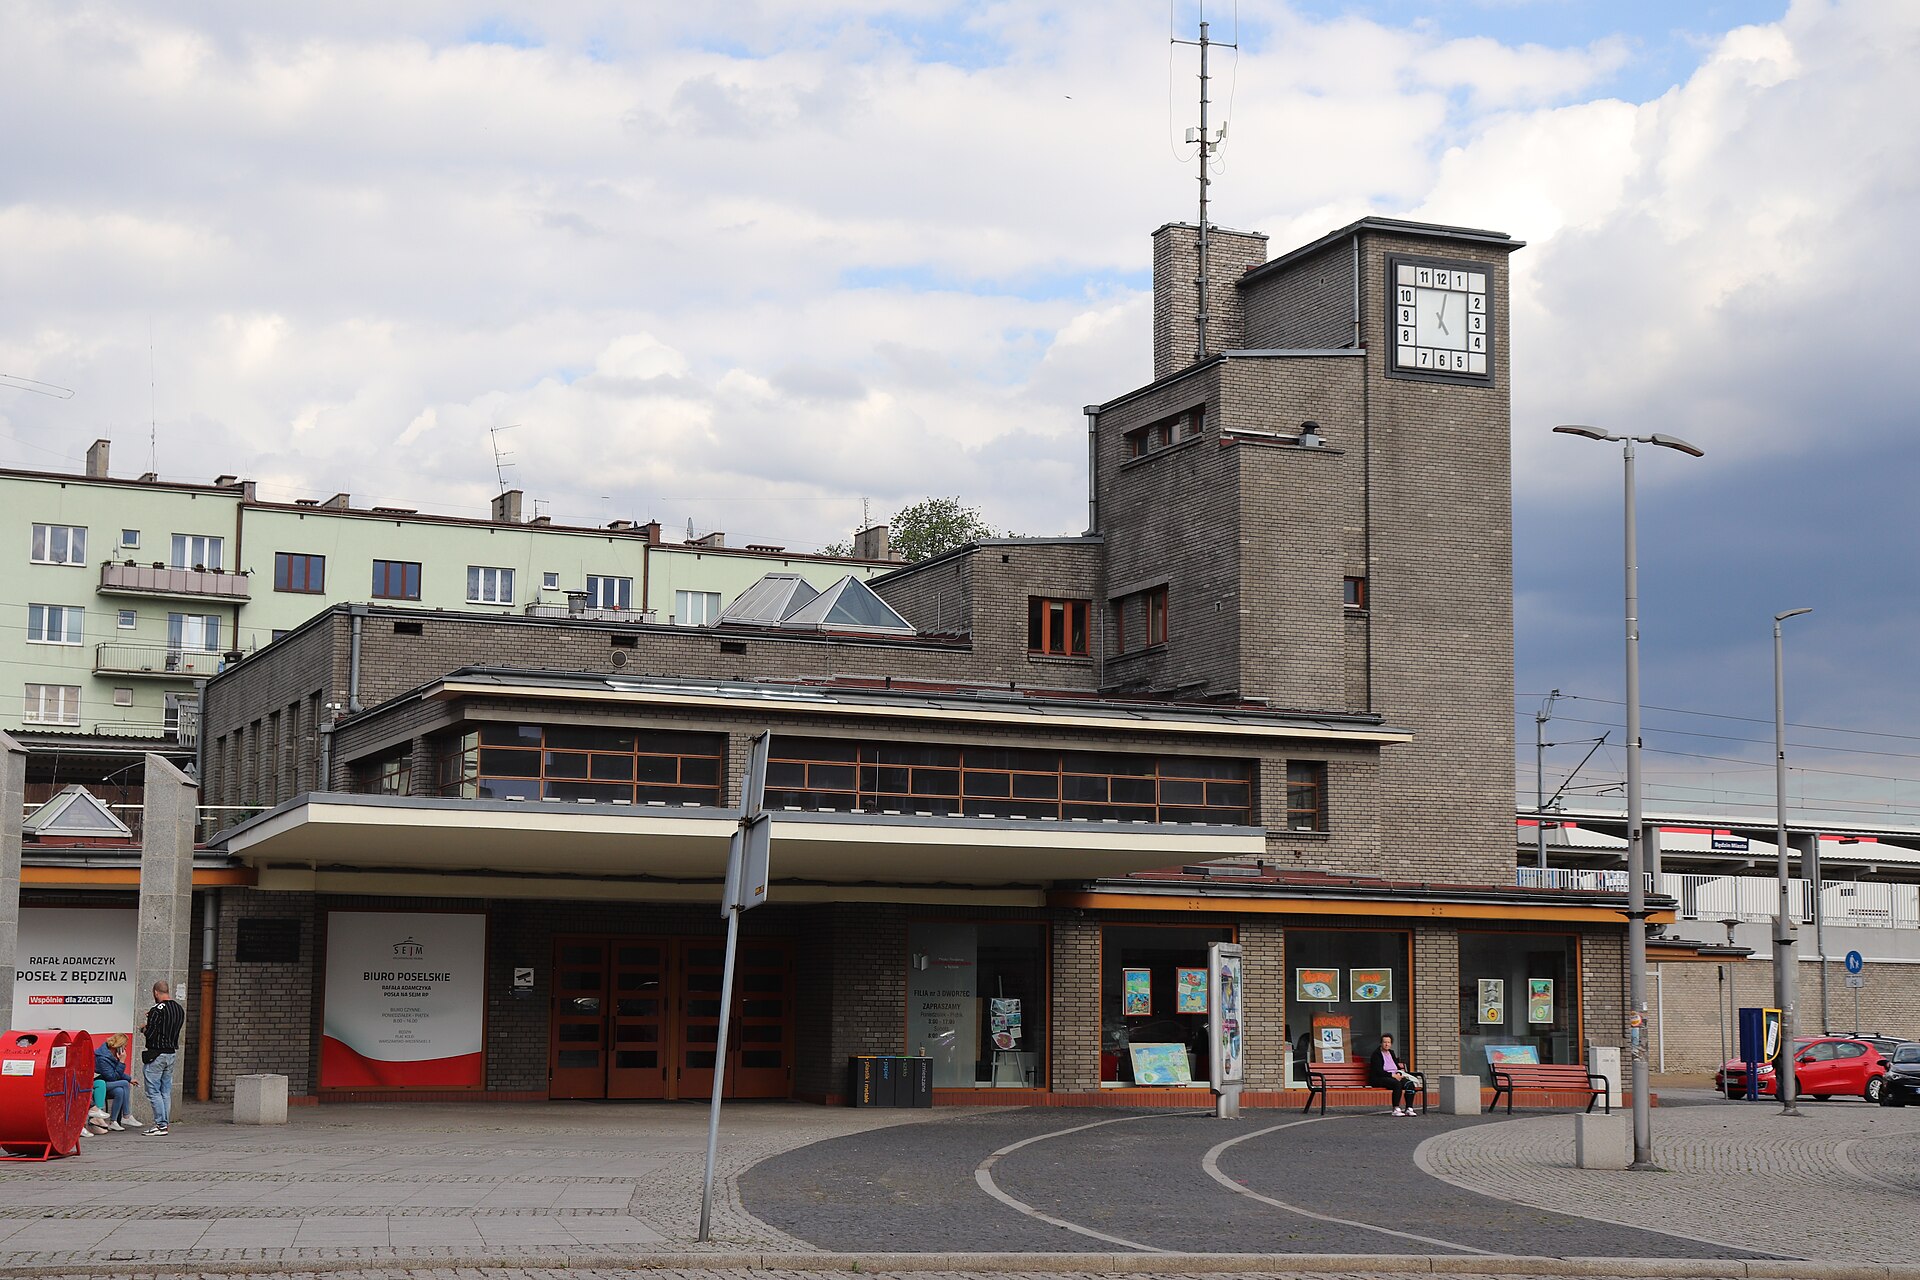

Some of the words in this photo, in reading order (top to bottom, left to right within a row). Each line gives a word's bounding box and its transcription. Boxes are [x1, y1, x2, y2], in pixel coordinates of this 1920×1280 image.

[1420, 271, 1428, 283] 11
[1437, 273, 1447, 285] 12
[1457, 275, 1461, 286] 1
[1401, 290, 1411, 302] 10
[1474, 298, 1480, 309] 2
[1403, 310, 1409, 321] 9
[1474, 318, 1480, 329] 3
[1403, 330, 1409, 341] 8
[1474, 337, 1480, 349] 4
[1422, 353, 1427, 364] 7
[1439, 355, 1445, 366] 6
[1457, 356, 1462, 367] 5
[394, 946, 423, 956] SEJM
[29, 956, 60, 965] RAFAŁ
[62, 957, 116, 965] ADAMCZYK
[16, 971, 57, 982] POSEŁ
[60, 971, 68, 981] Z
[71, 971, 127, 984] BĘDZINA
[363, 972, 395, 981] BIURO
[397, 972, 451, 982] POSELSKIE
[942, 990, 970, 998] DWORZEC
[30, 996, 63, 1004] Wspólnie
[77, 996, 111, 1005] ZAGŁĘBIA
